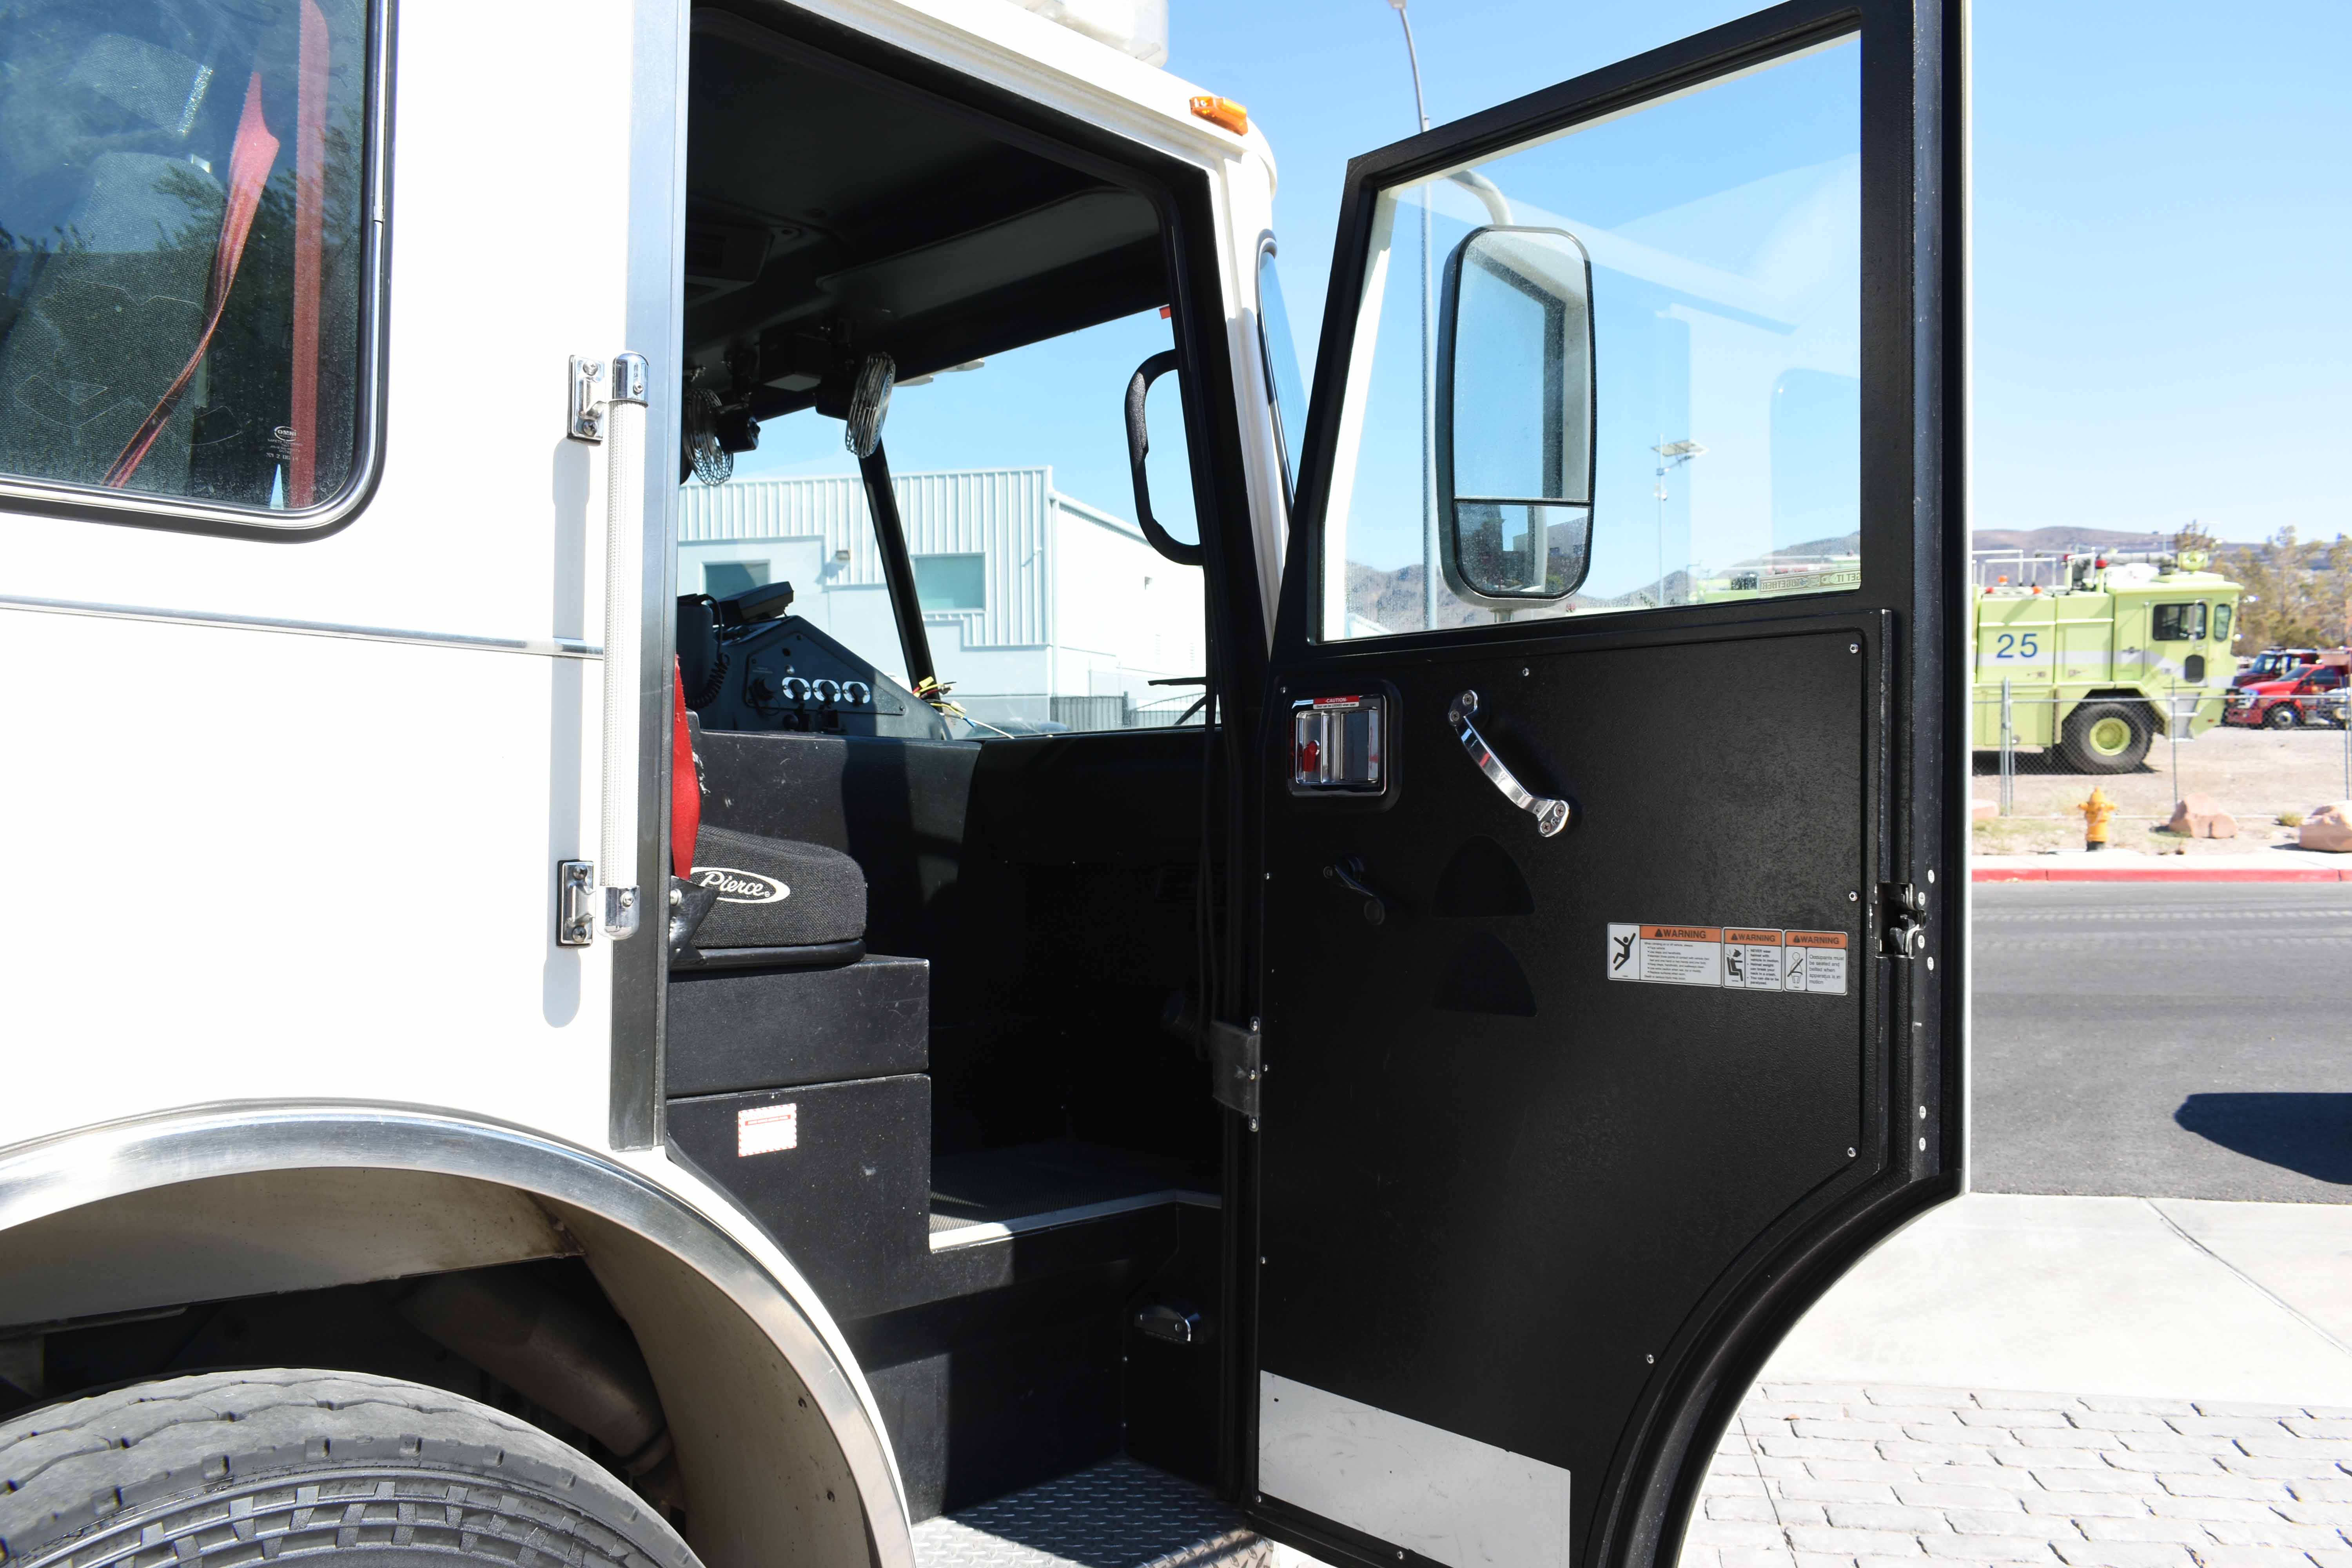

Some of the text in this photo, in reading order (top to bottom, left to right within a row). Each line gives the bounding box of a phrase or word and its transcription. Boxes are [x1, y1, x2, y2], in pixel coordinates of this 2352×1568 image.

[1996, 633, 2038, 658] 25
[700, 871, 764, 896] Pierce
[1663, 929, 1706, 938] WARNING
[1738, 933, 1775, 942] WARNING
[1800, 936, 1839, 944] WARNING
